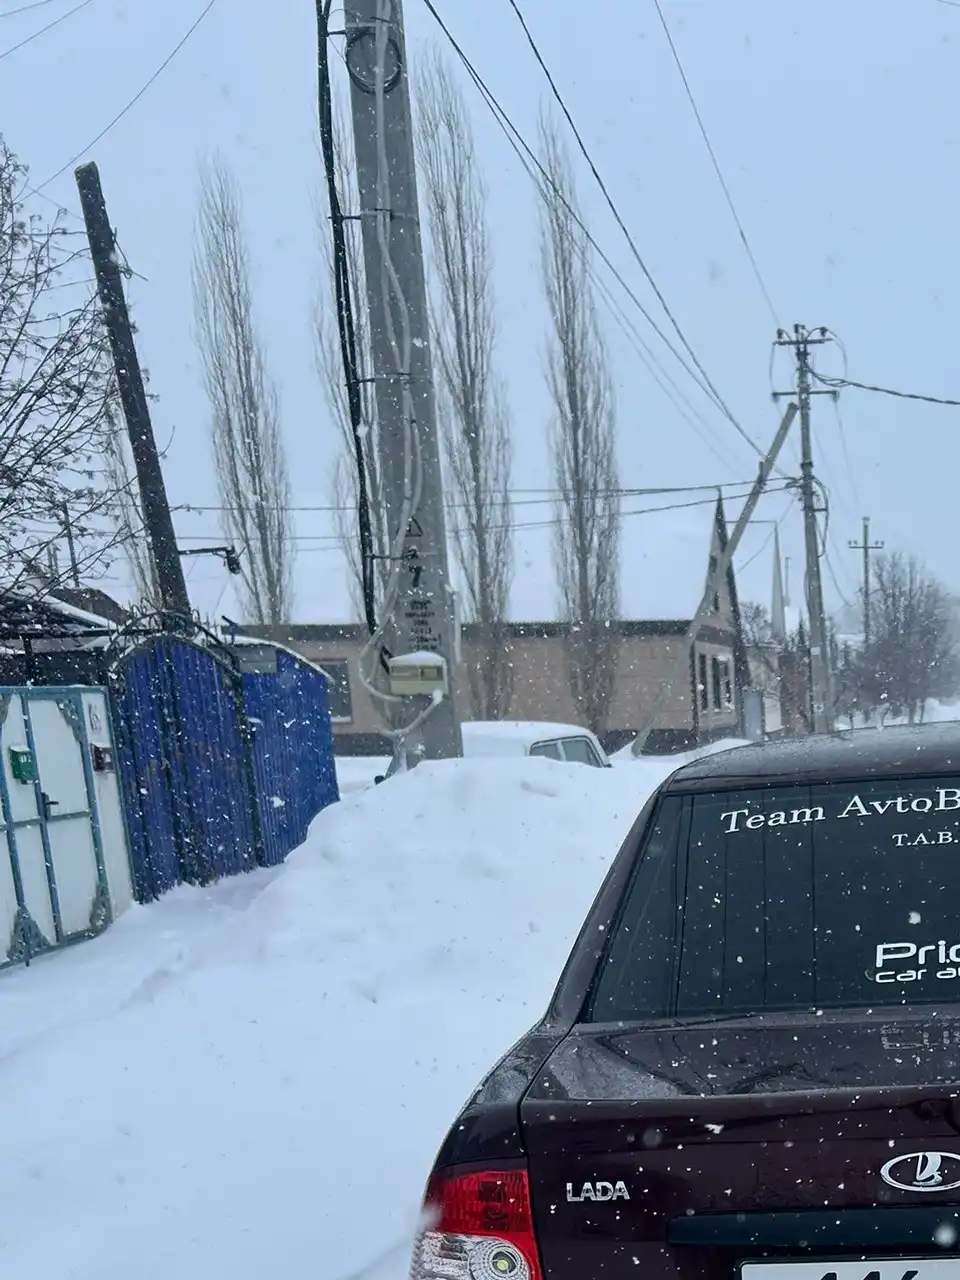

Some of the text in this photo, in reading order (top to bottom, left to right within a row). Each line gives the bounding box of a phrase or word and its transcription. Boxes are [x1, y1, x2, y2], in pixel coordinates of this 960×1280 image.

[720, 806, 826, 833] Team
[875, 969, 928, 983] car
[566, 1181, 630, 1202] LADA
